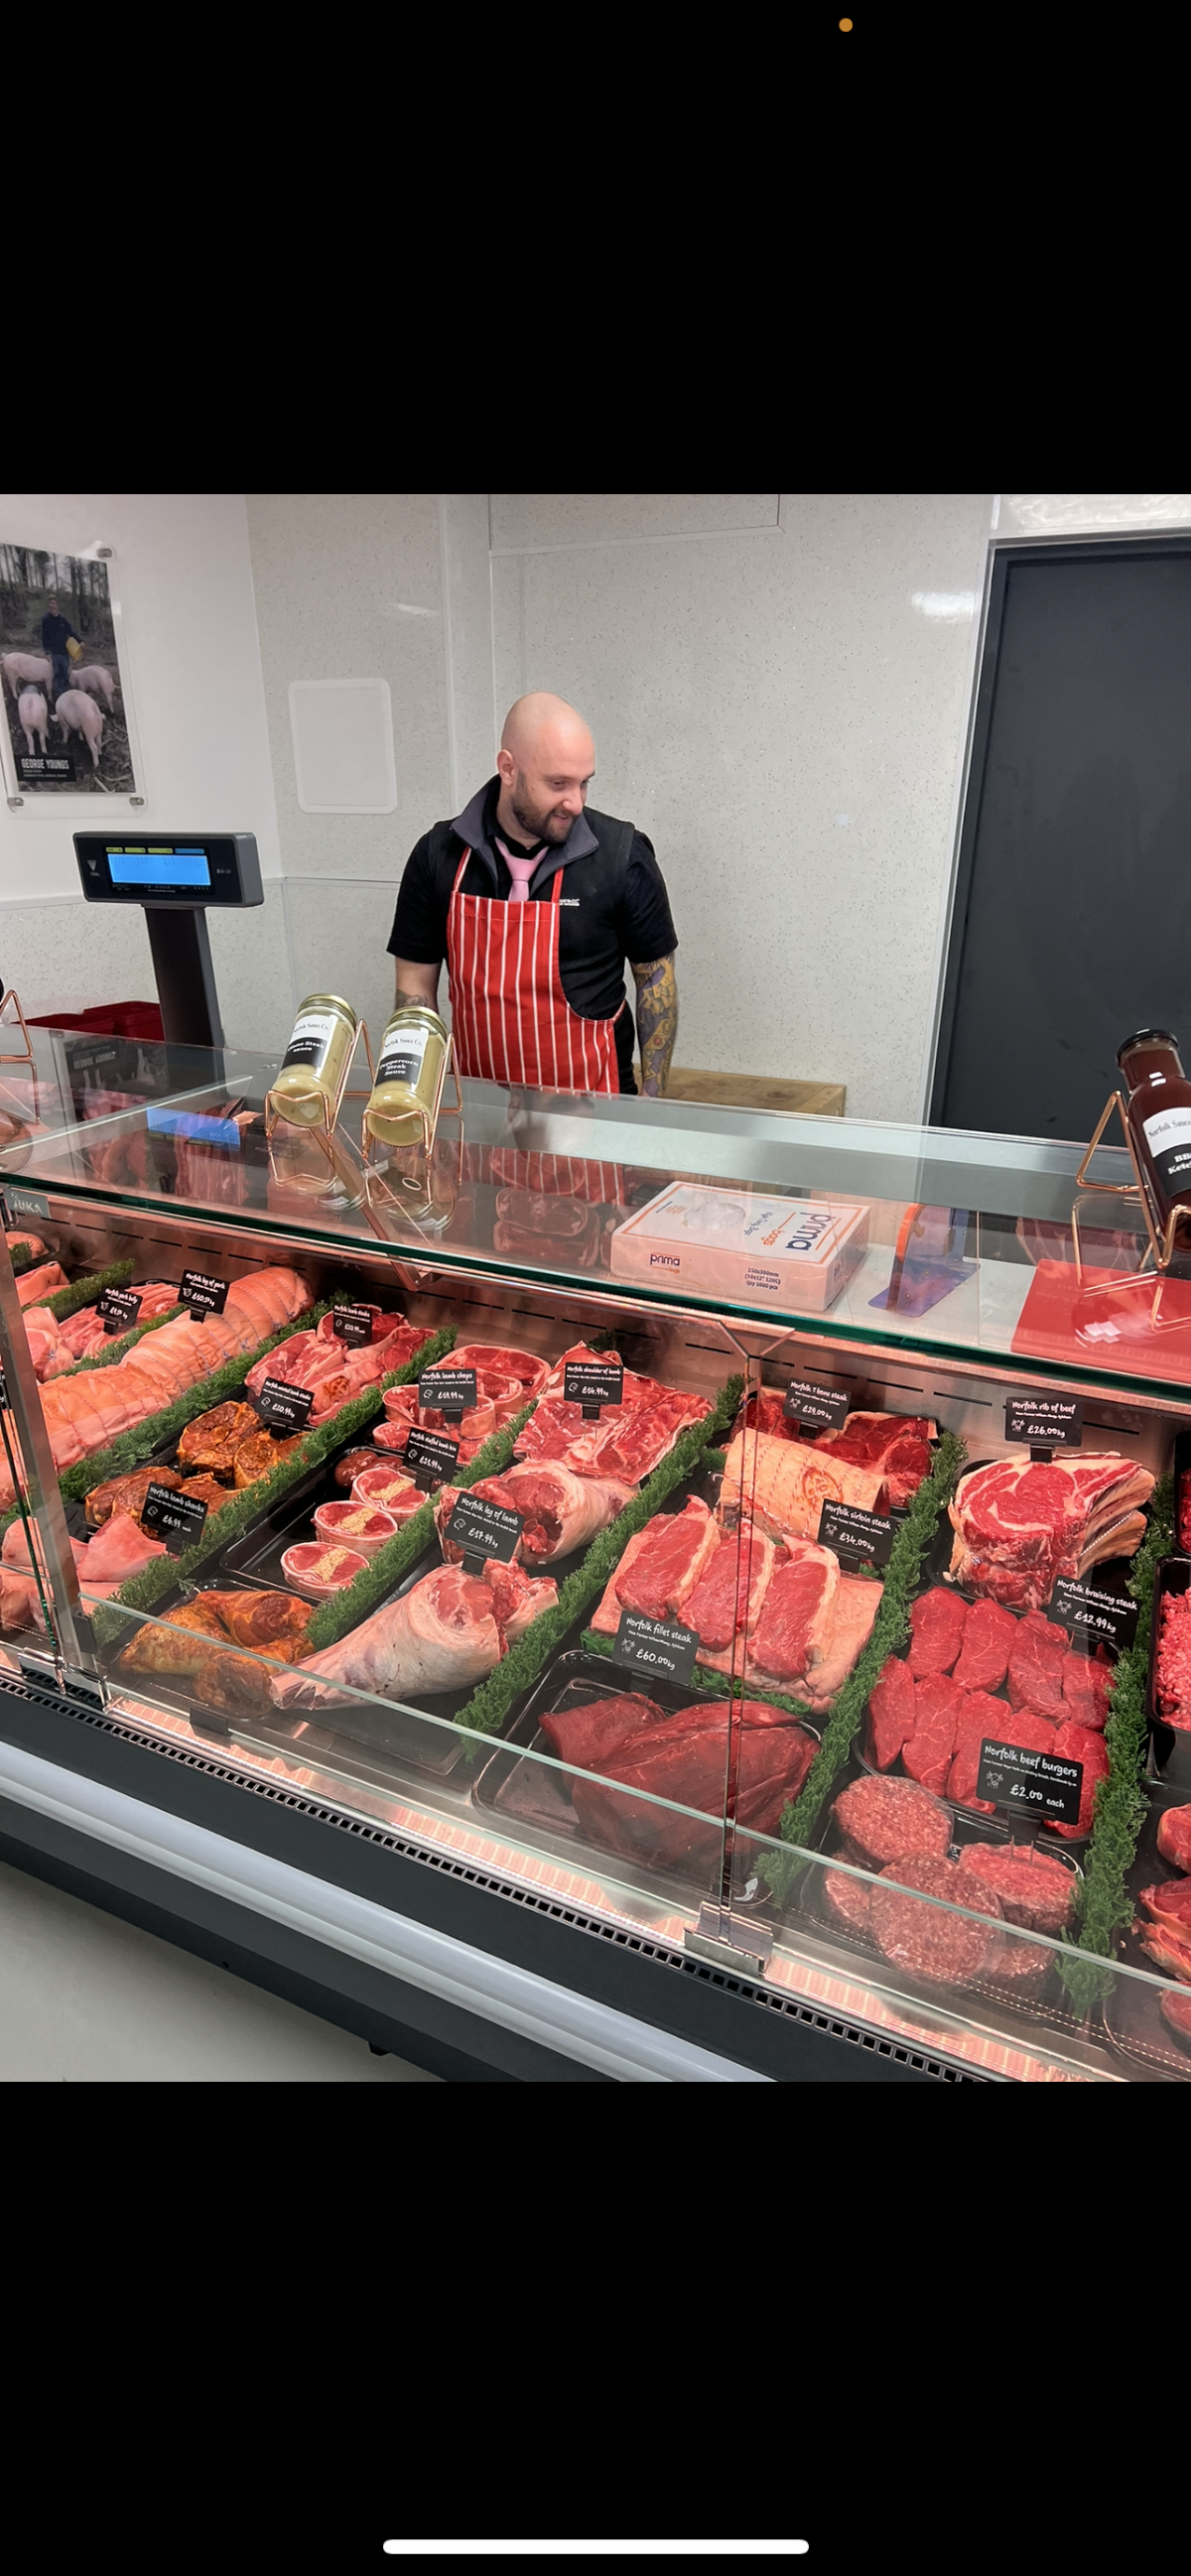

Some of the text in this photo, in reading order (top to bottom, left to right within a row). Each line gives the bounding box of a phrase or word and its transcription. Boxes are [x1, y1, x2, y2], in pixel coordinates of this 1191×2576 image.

[21, 758, 69, 769] GEORGE YOUNGS
[1168, 1160, 1191, 1175] Ketc
[1174, 1152, 1191, 1163] BB
[785, 1212, 837, 1251] prima
[650, 1253, 681, 1266] prima
[790, 1381, 812, 1392] Norfolk
[1011, 1400, 1038, 1411] Norfolk
[1038, 1402, 1050, 1411] rib
[1050, 1402, 1060, 1413] of
[1059, 1403, 1076, 1415] beef
[149, 1486, 170, 1499] Norfolk
[170, 1492, 185, 1505] lamb
[185, 1499, 204, 1513] shanks
[461, 1497, 483, 1512] Norfolk
[483, 1504, 493, 1518] leg
[493, 1510, 503, 1521] of
[501, 1511, 519, 1526] lamb
[825, 1503, 850, 1517] Norfolk
[850, 1511, 870, 1524] sirloin
[871, 1518, 891, 1530] steak
[1057, 1579, 1085, 1594] Norfolk
[1085, 1587, 1116, 1606] braising
[1116, 1599, 1137, 1610] steak
[626, 1616, 652, 1632] Norfolk
[653, 1622, 671, 1637] fillet
[671, 1632, 692, 1644] steak
[985, 1744, 1018, 1762] Norfolk
[1019, 1752, 1041, 1769] beef
[1041, 1757, 1078, 1778] burgers
[1009, 1783, 1065, 1809] £2.00 each
